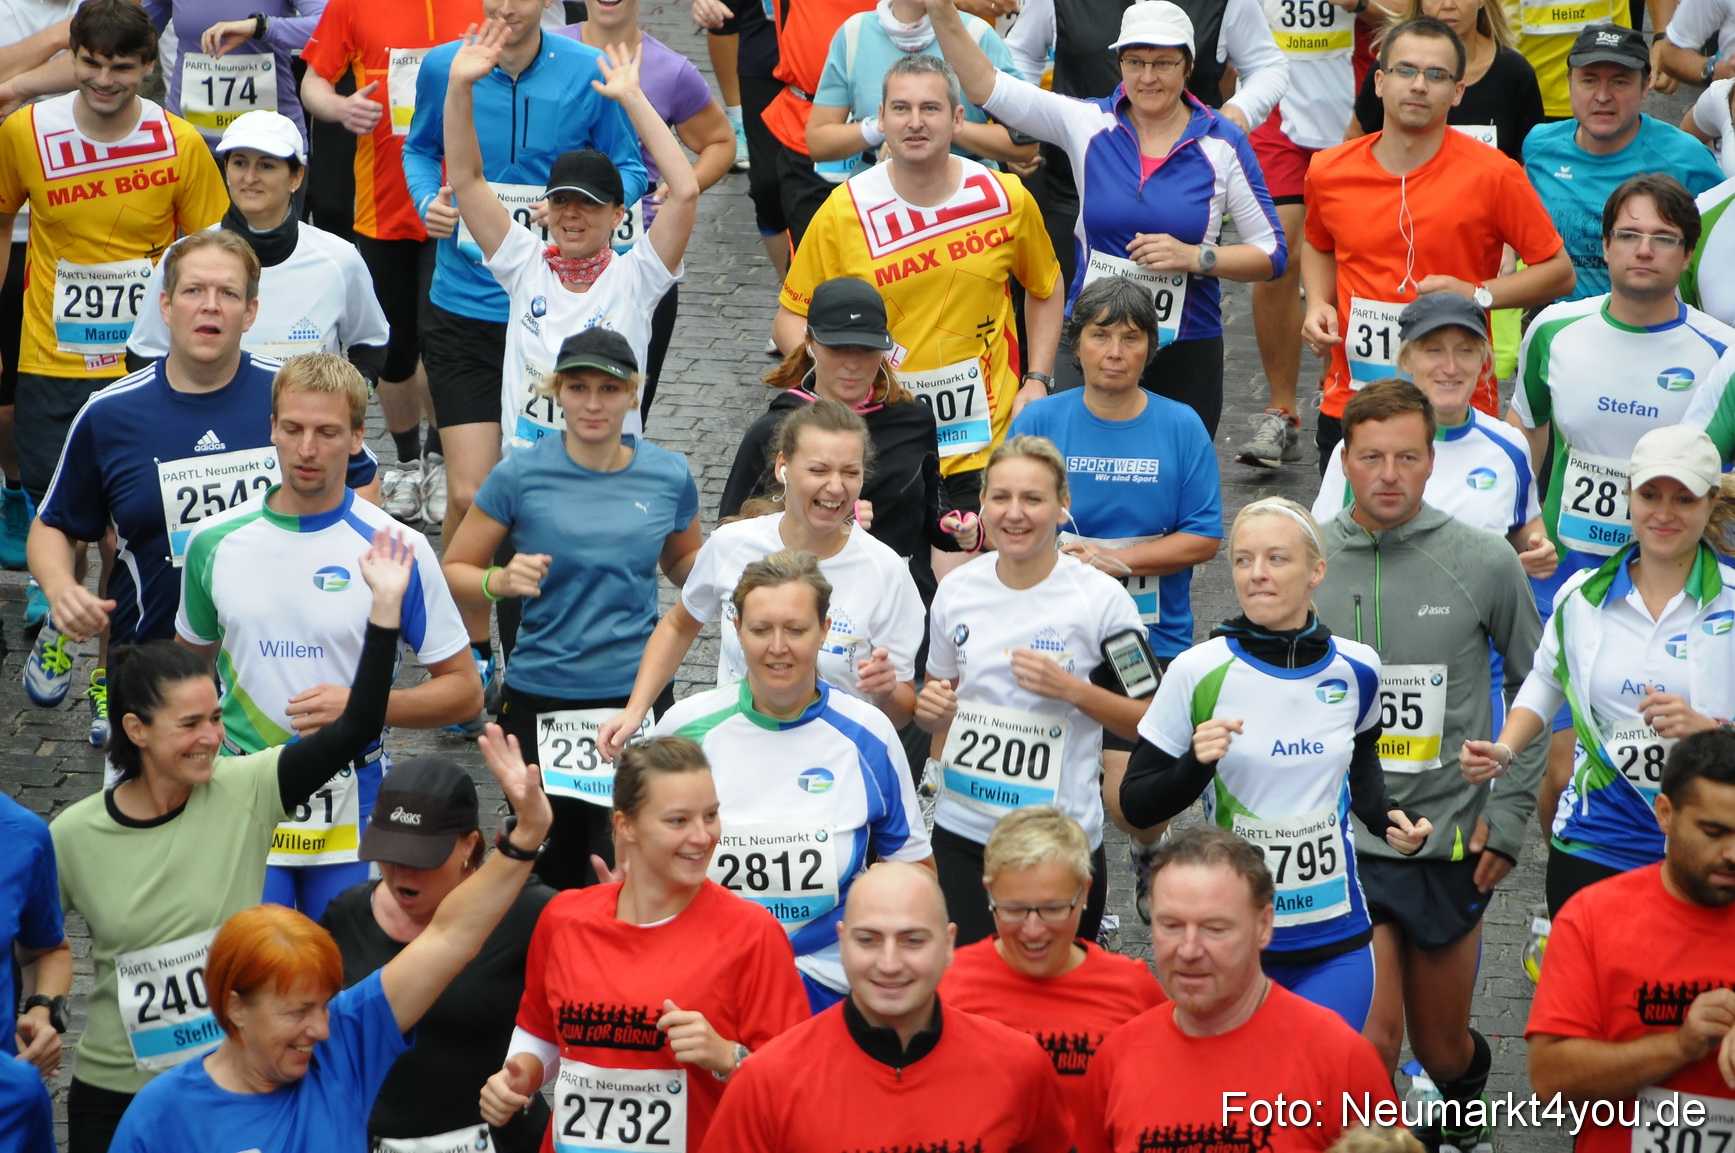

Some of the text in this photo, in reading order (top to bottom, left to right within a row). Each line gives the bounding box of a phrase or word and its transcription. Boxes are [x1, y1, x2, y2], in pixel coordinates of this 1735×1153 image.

[1281, 0, 1335, 28] 359
[1551, 8, 1585, 20] Heinz
[1286, 36, 1328, 49] Johann
[185, 61, 258, 72] PARTL Neumarkt
[391, 56, 420, 65] PARTL
[202, 76, 257, 107] 174
[46, 167, 180, 207] MAX BÖGL
[874, 226, 1015, 288] MAX BÖGL
[57, 269, 136, 280] PARTL Neumarkt
[1091, 259, 1168, 284] PARTL Neumarkt
[64, 283, 146, 318] 2976
[1352, 307, 1379, 320] PARTL
[85, 327, 127, 341] Marco
[1355, 323, 1398, 360] 31
[916, 373, 965, 389] Neumarkt
[1597, 396, 1659, 418] Stefan
[194, 442, 226, 452] adidas
[163, 461, 260, 483] PARTL Neumarkt
[1068, 457, 1158, 474] SPORTWEISS
[1570, 457, 1602, 474] PARTL
[1095, 474, 1158, 483] Wir sind Sport.
[1428, 605, 1450, 615] asics
[259, 640, 323, 658] Willem
[957, 711, 1045, 736] PARTL Neumarkt
[1614, 729, 1648, 741] PARTL
[953, 729, 1050, 781] 2200
[1271, 738, 1325, 757] Anke
[970, 780, 1020, 805] Erwina
[1235, 820, 1326, 839] PARTL Neumarkt
[272, 833, 326, 851] Willem
[749, 832, 811, 846] Neumarkt
[717, 848, 824, 891] 2812
[1275, 895, 1314, 912] Anke
[120, 961, 157, 978] PARTL
[1644, 1004, 1678, 1020] RUN
[173, 1021, 220, 1047] Steffi
[561, 1022, 584, 1041] RUN
[586, 1023, 612, 1042] FOR
[560, 1070, 661, 1093] PARTL Neumarkt
[562, 1092, 672, 1146] 2732
